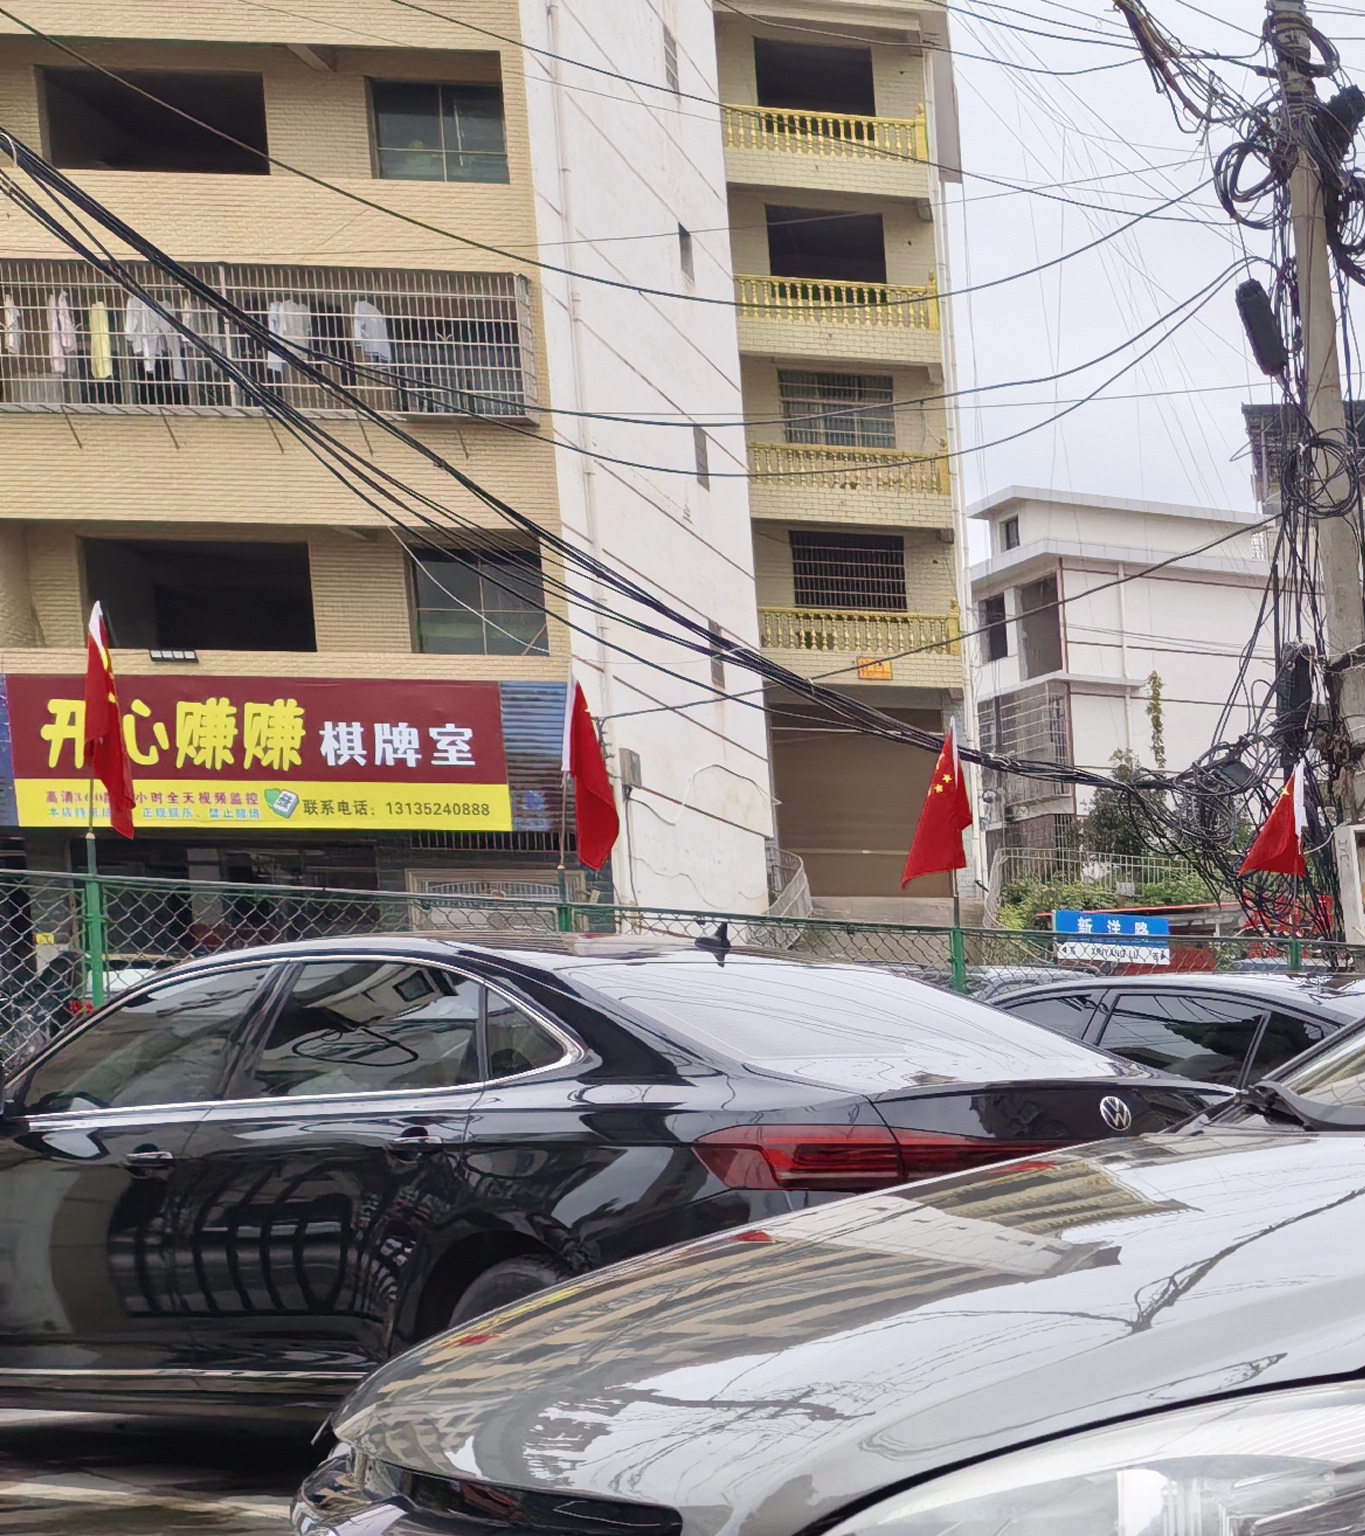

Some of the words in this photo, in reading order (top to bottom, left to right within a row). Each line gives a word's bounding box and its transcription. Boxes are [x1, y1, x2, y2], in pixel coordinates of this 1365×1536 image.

[40, 697, 306, 771] 开心赚赚
[319, 720, 477, 768] 棋牌室
